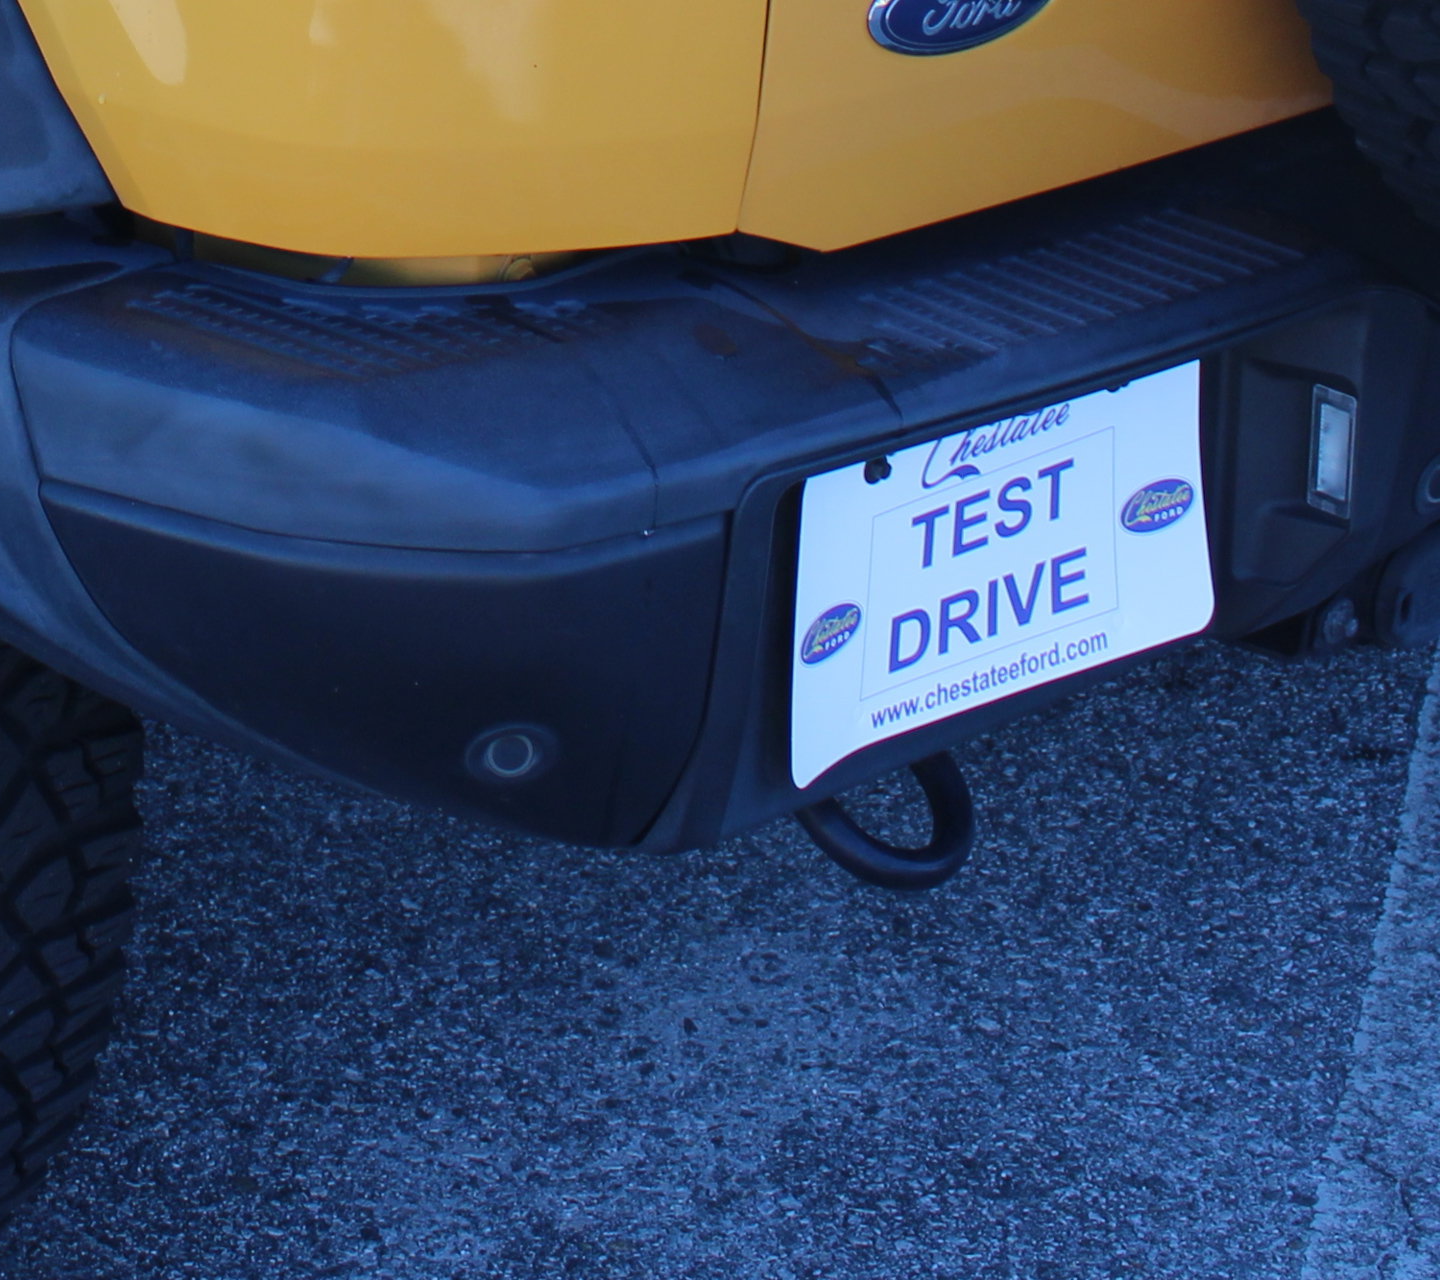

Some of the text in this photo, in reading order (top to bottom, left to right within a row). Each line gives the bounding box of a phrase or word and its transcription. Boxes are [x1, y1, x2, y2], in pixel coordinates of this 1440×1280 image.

[911, 457, 1075, 569] TEST
[887, 546, 1091, 675] DRIVE
[870, 631, 1109, 730] www.chestateeford.com
